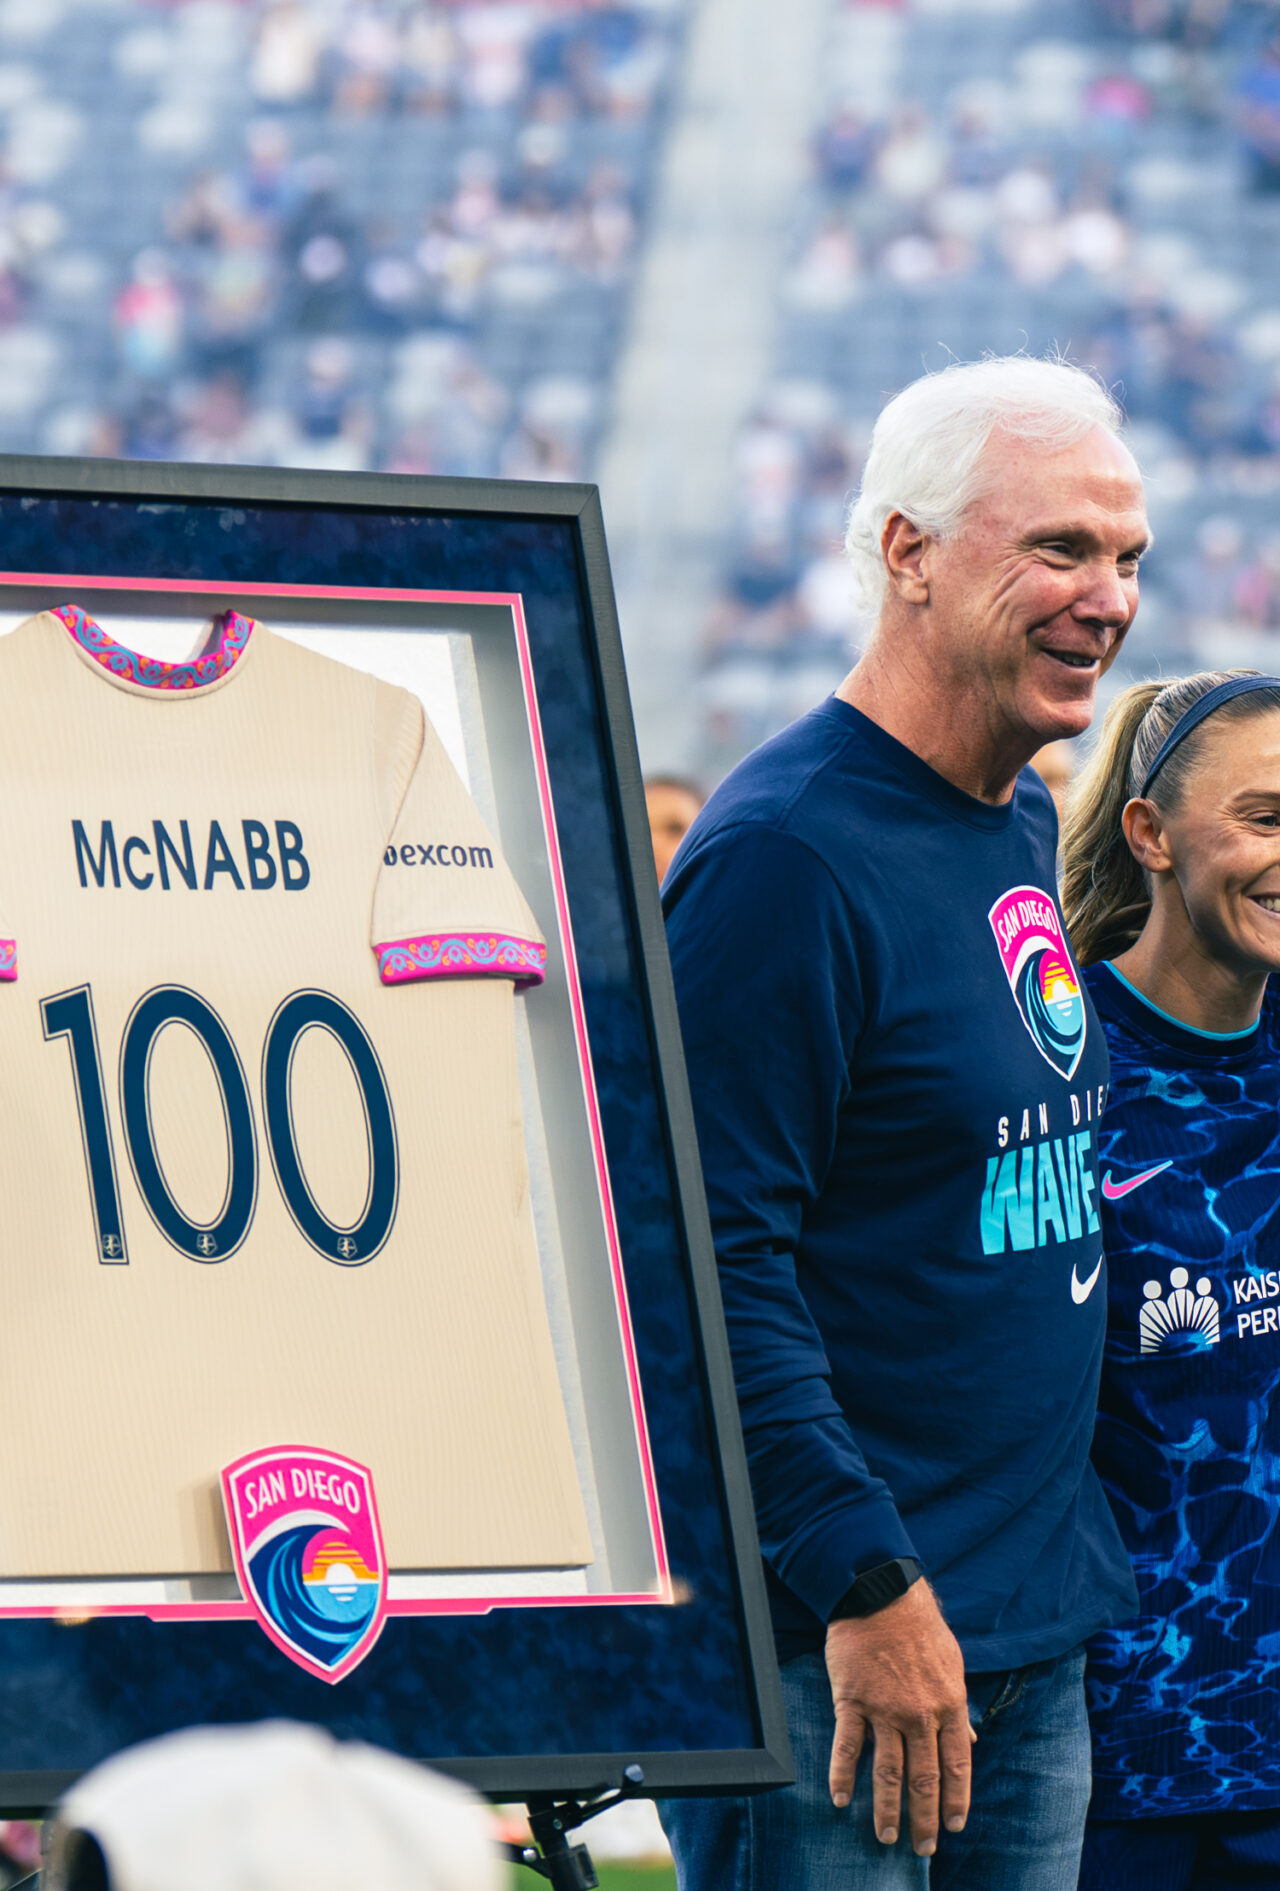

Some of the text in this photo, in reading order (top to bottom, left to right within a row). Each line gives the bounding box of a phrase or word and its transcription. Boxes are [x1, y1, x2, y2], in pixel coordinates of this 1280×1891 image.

[71, 819, 311, 892] McNABB
[997, 900, 1058, 953] SAN DIEGO
[39, 983, 400, 1267] 100
[998, 1085, 1105, 1148] SAN DIE
[981, 1130, 1101, 1256] WAVE
[245, 1468, 360, 1519] SAN DIEGO
